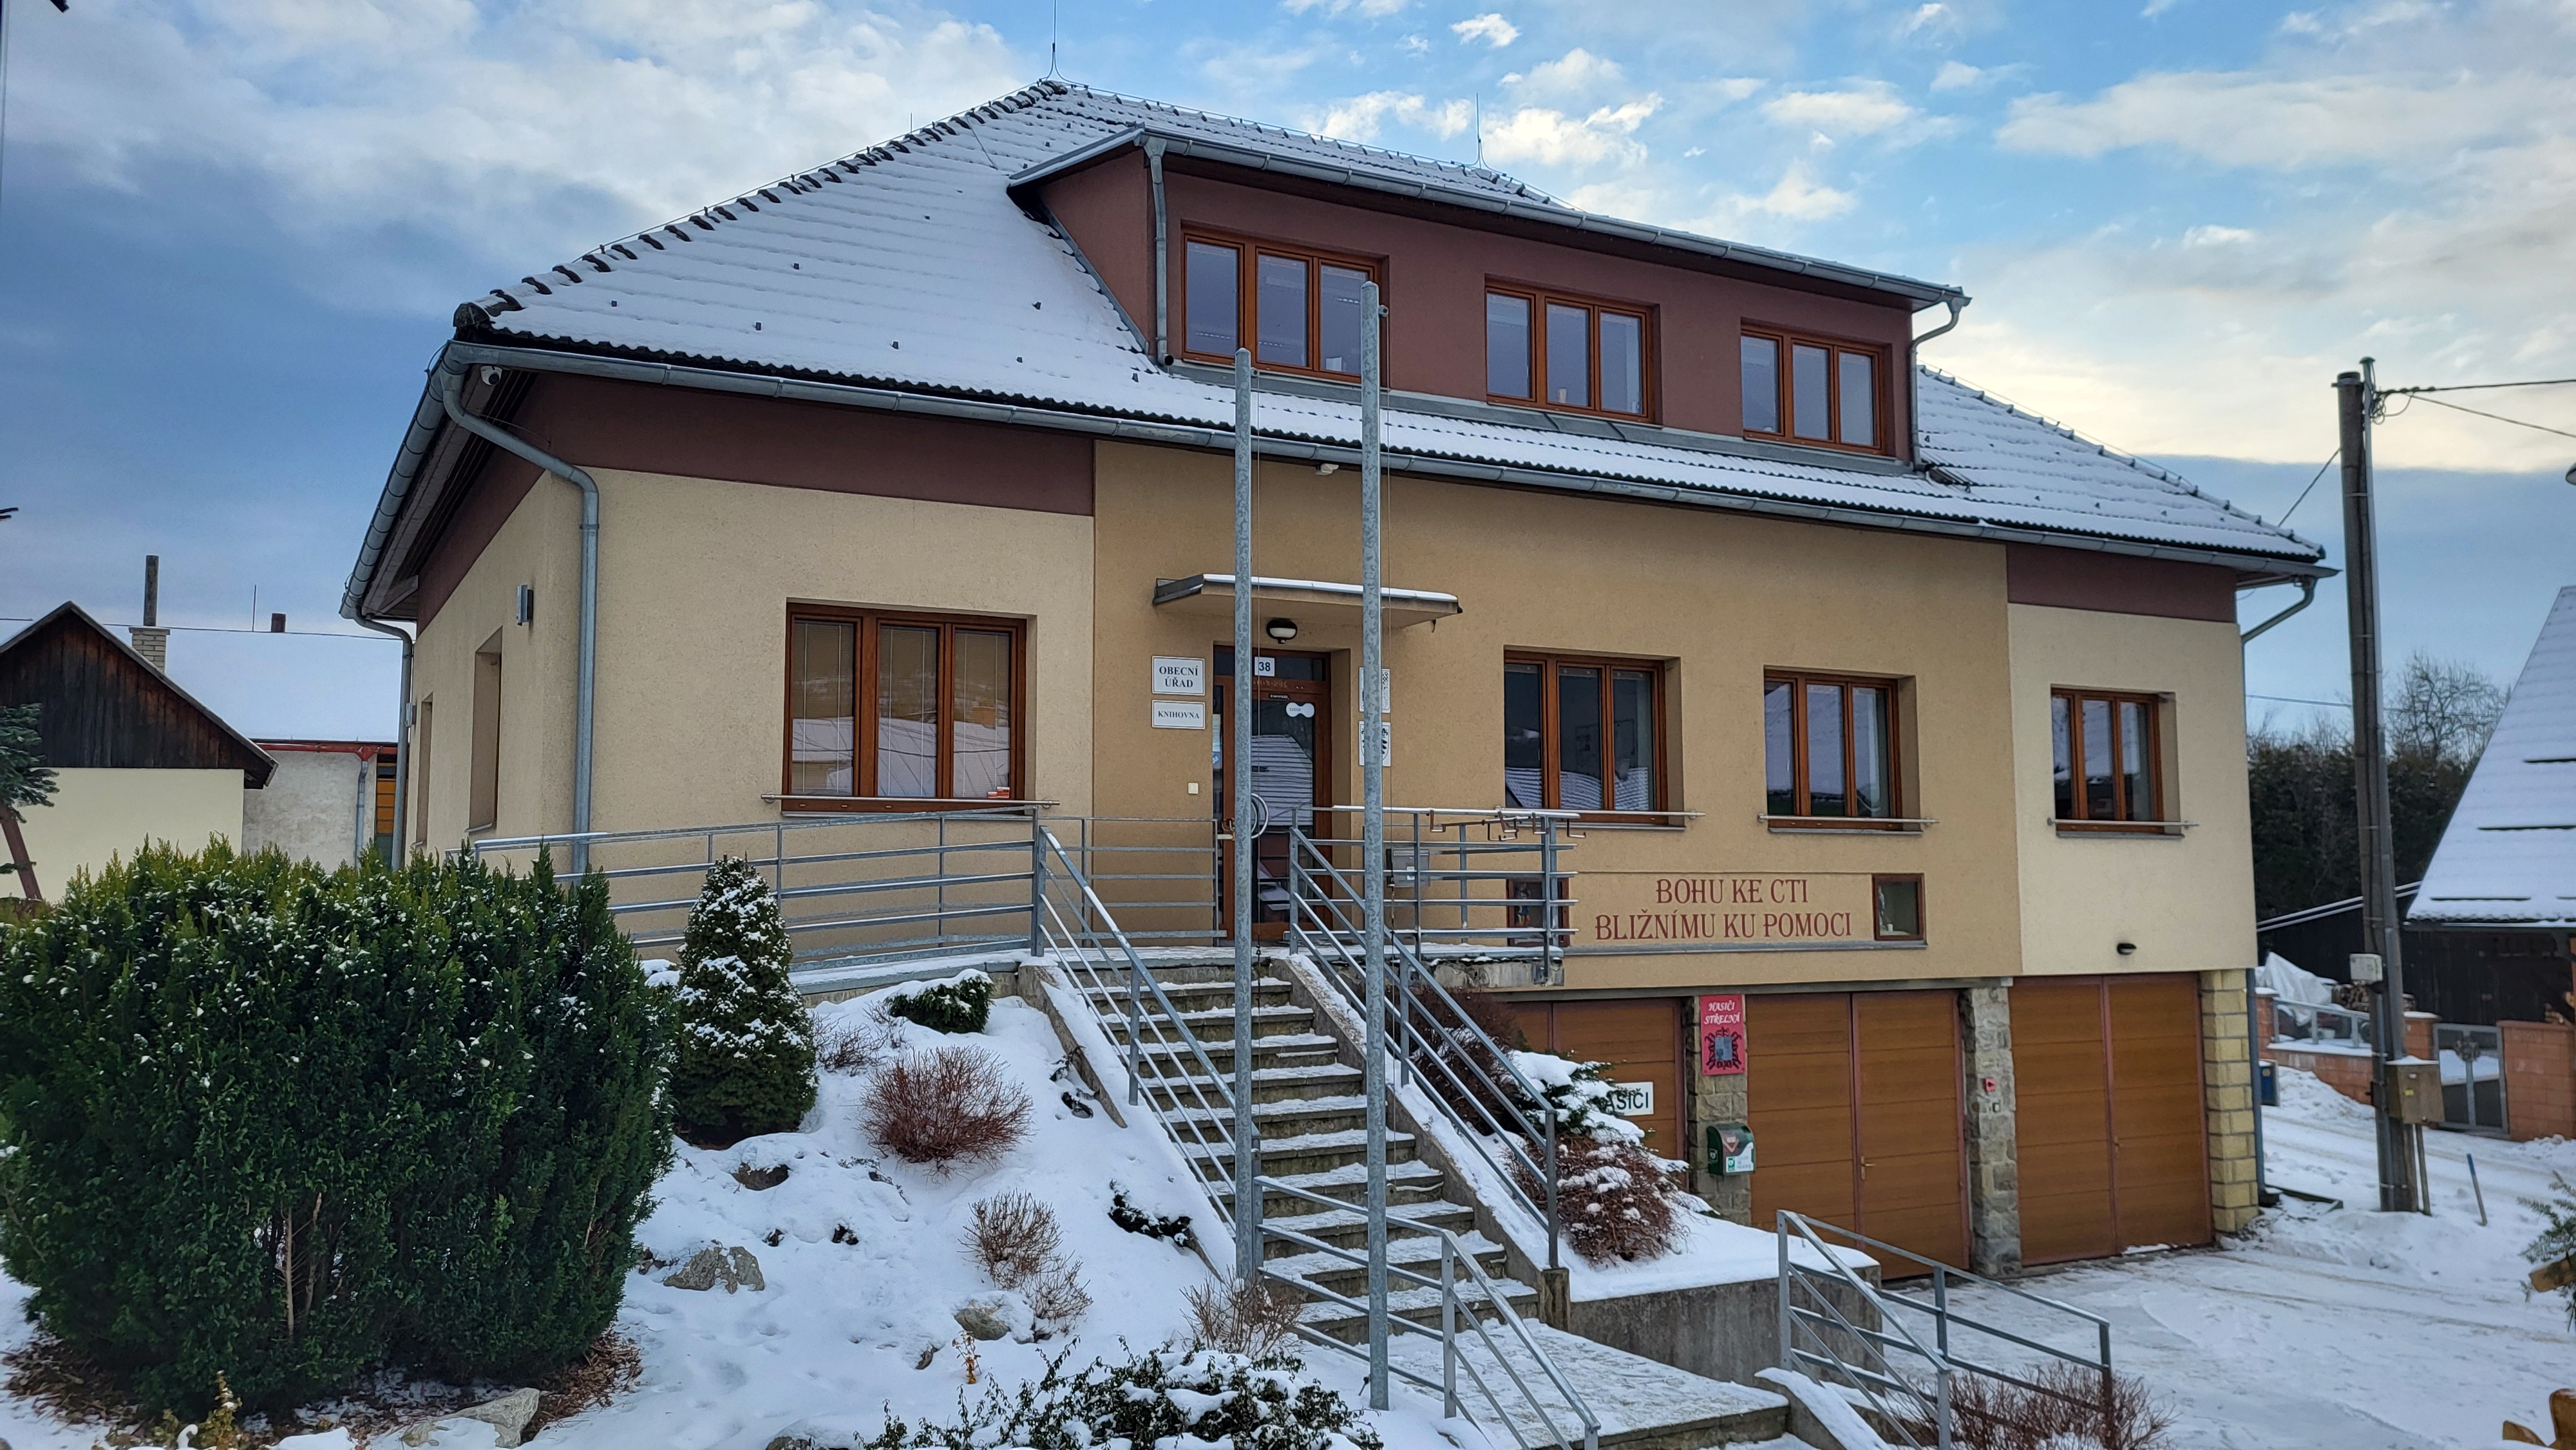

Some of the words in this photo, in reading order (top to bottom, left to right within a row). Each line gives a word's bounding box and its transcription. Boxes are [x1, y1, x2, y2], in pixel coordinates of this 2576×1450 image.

[1159, 666, 1198, 675] OBECNÍ
[1258, 662, 1271, 672] 38
[1165, 676, 1193, 687] ÚŘAD
[1158, 711, 1200, 719] KNIHOVNA
[1656, 878, 1724, 903] BOHU
[1732, 879, 1764, 903] KE
[1770, 878, 1808, 903] CTI
[1595, 909, 1716, 940] BLIŽNÍMU
[1723, 913, 1756, 938] KU
[1763, 912, 1852, 937] POMOCI
[1708, 999, 1736, 1012] HASIČI
[1703, 1012, 1741, 1025] STŘELNÁ
[1606, 1088, 1649, 1110] ASIČI
